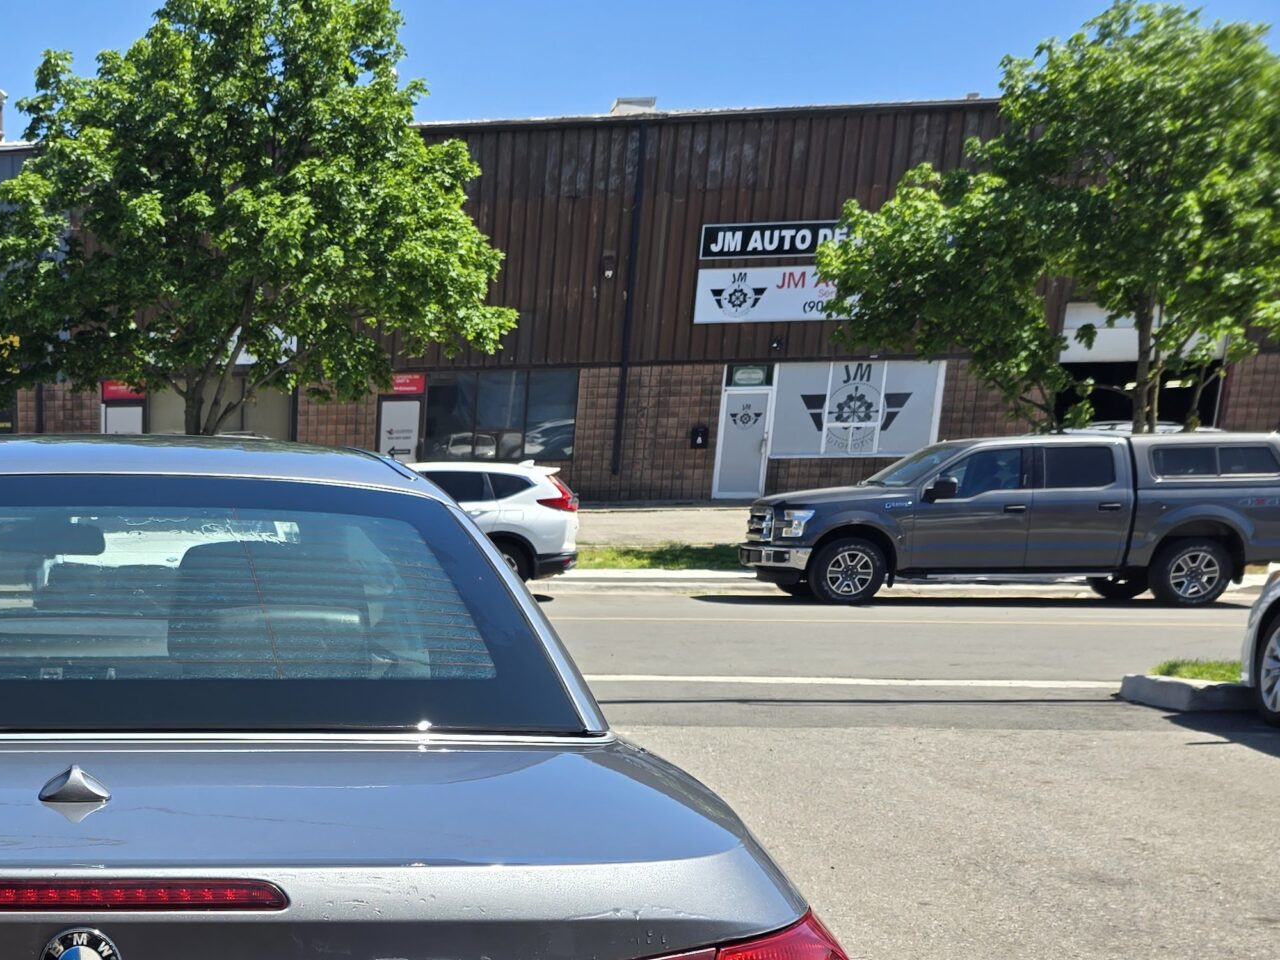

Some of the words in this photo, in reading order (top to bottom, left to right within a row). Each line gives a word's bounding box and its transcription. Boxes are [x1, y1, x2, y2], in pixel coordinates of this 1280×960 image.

[710, 231, 743, 252] JM
[746, 228, 812, 252] AUTO
[817, 227, 856, 248] DE
[732, 272, 748, 284] JM
[776, 271, 807, 289] JM
[803, 300, 825, 314] (90
[843, 363, 872, 384] JM
[48, 932, 113, 958] BMW
